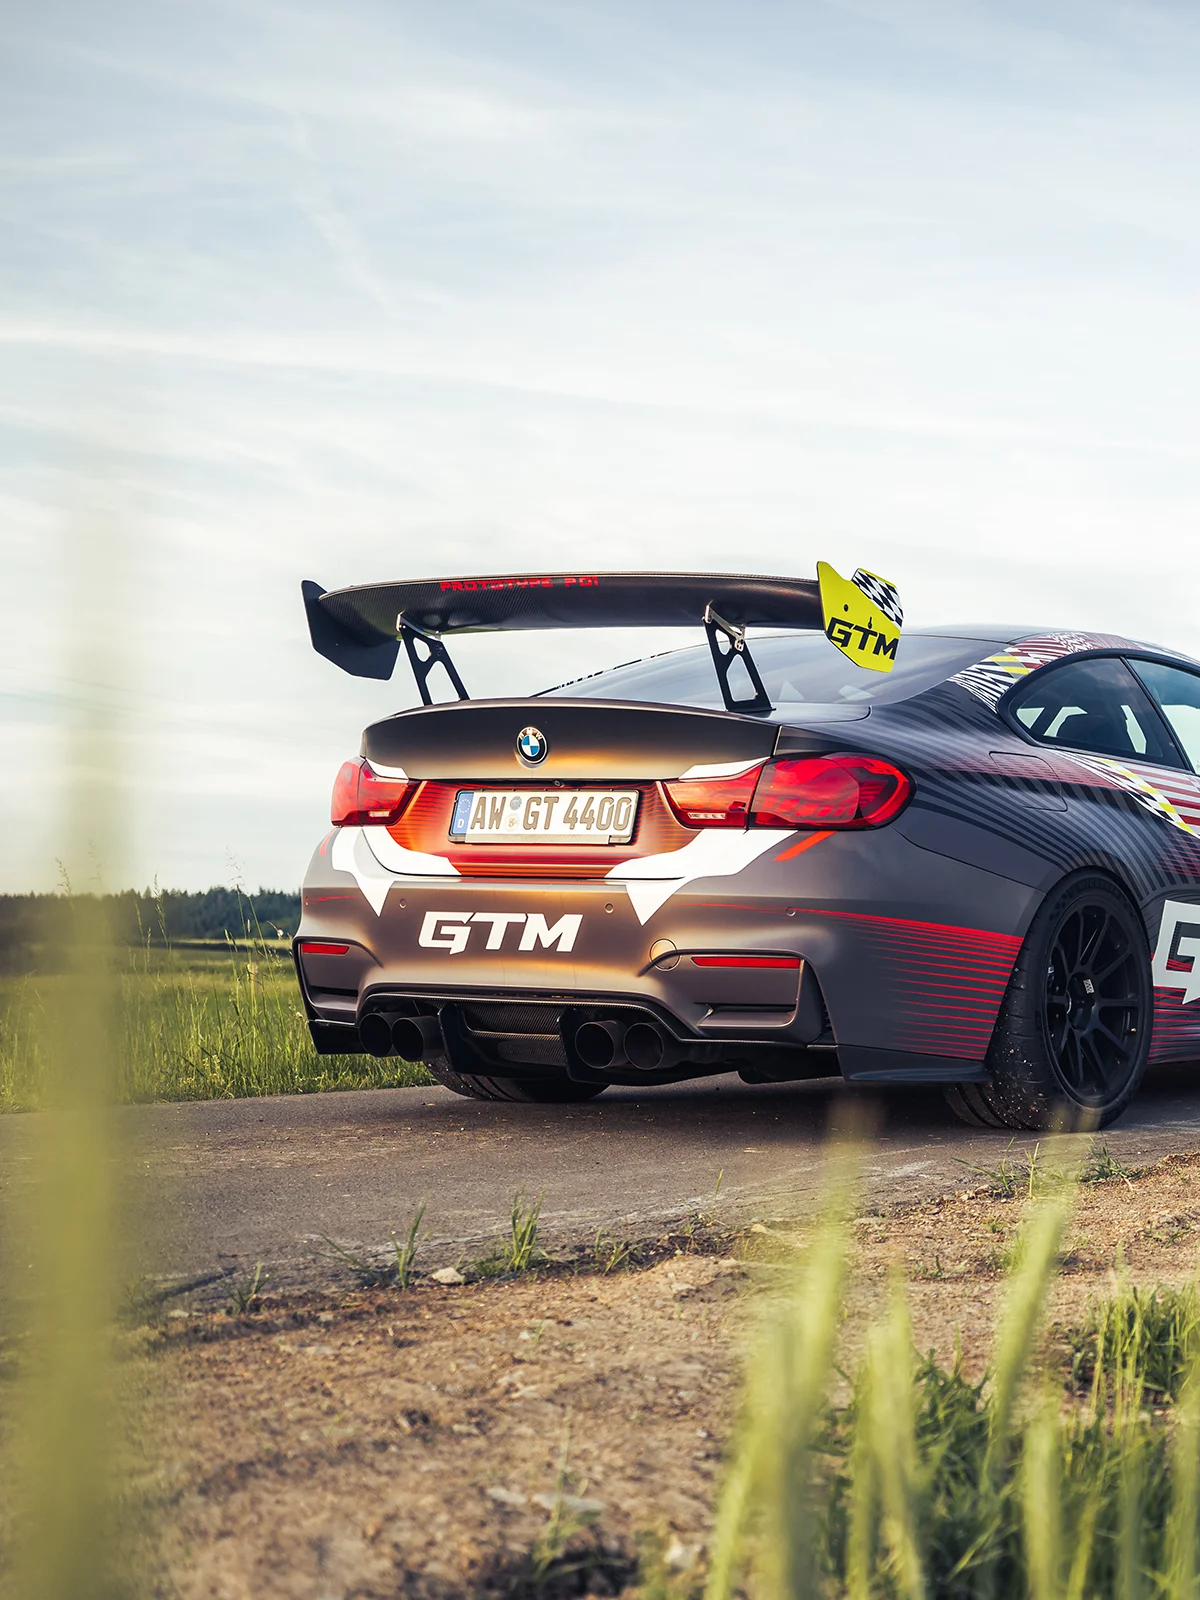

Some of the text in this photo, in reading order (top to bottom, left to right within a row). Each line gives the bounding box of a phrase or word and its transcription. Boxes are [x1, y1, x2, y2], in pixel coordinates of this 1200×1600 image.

[440, 577, 553, 592] PROTOTYPE
[826, 616, 899, 660] GTM
[470, 796, 633, 831] AW GT 4400
[418, 911, 584, 955] GTM
